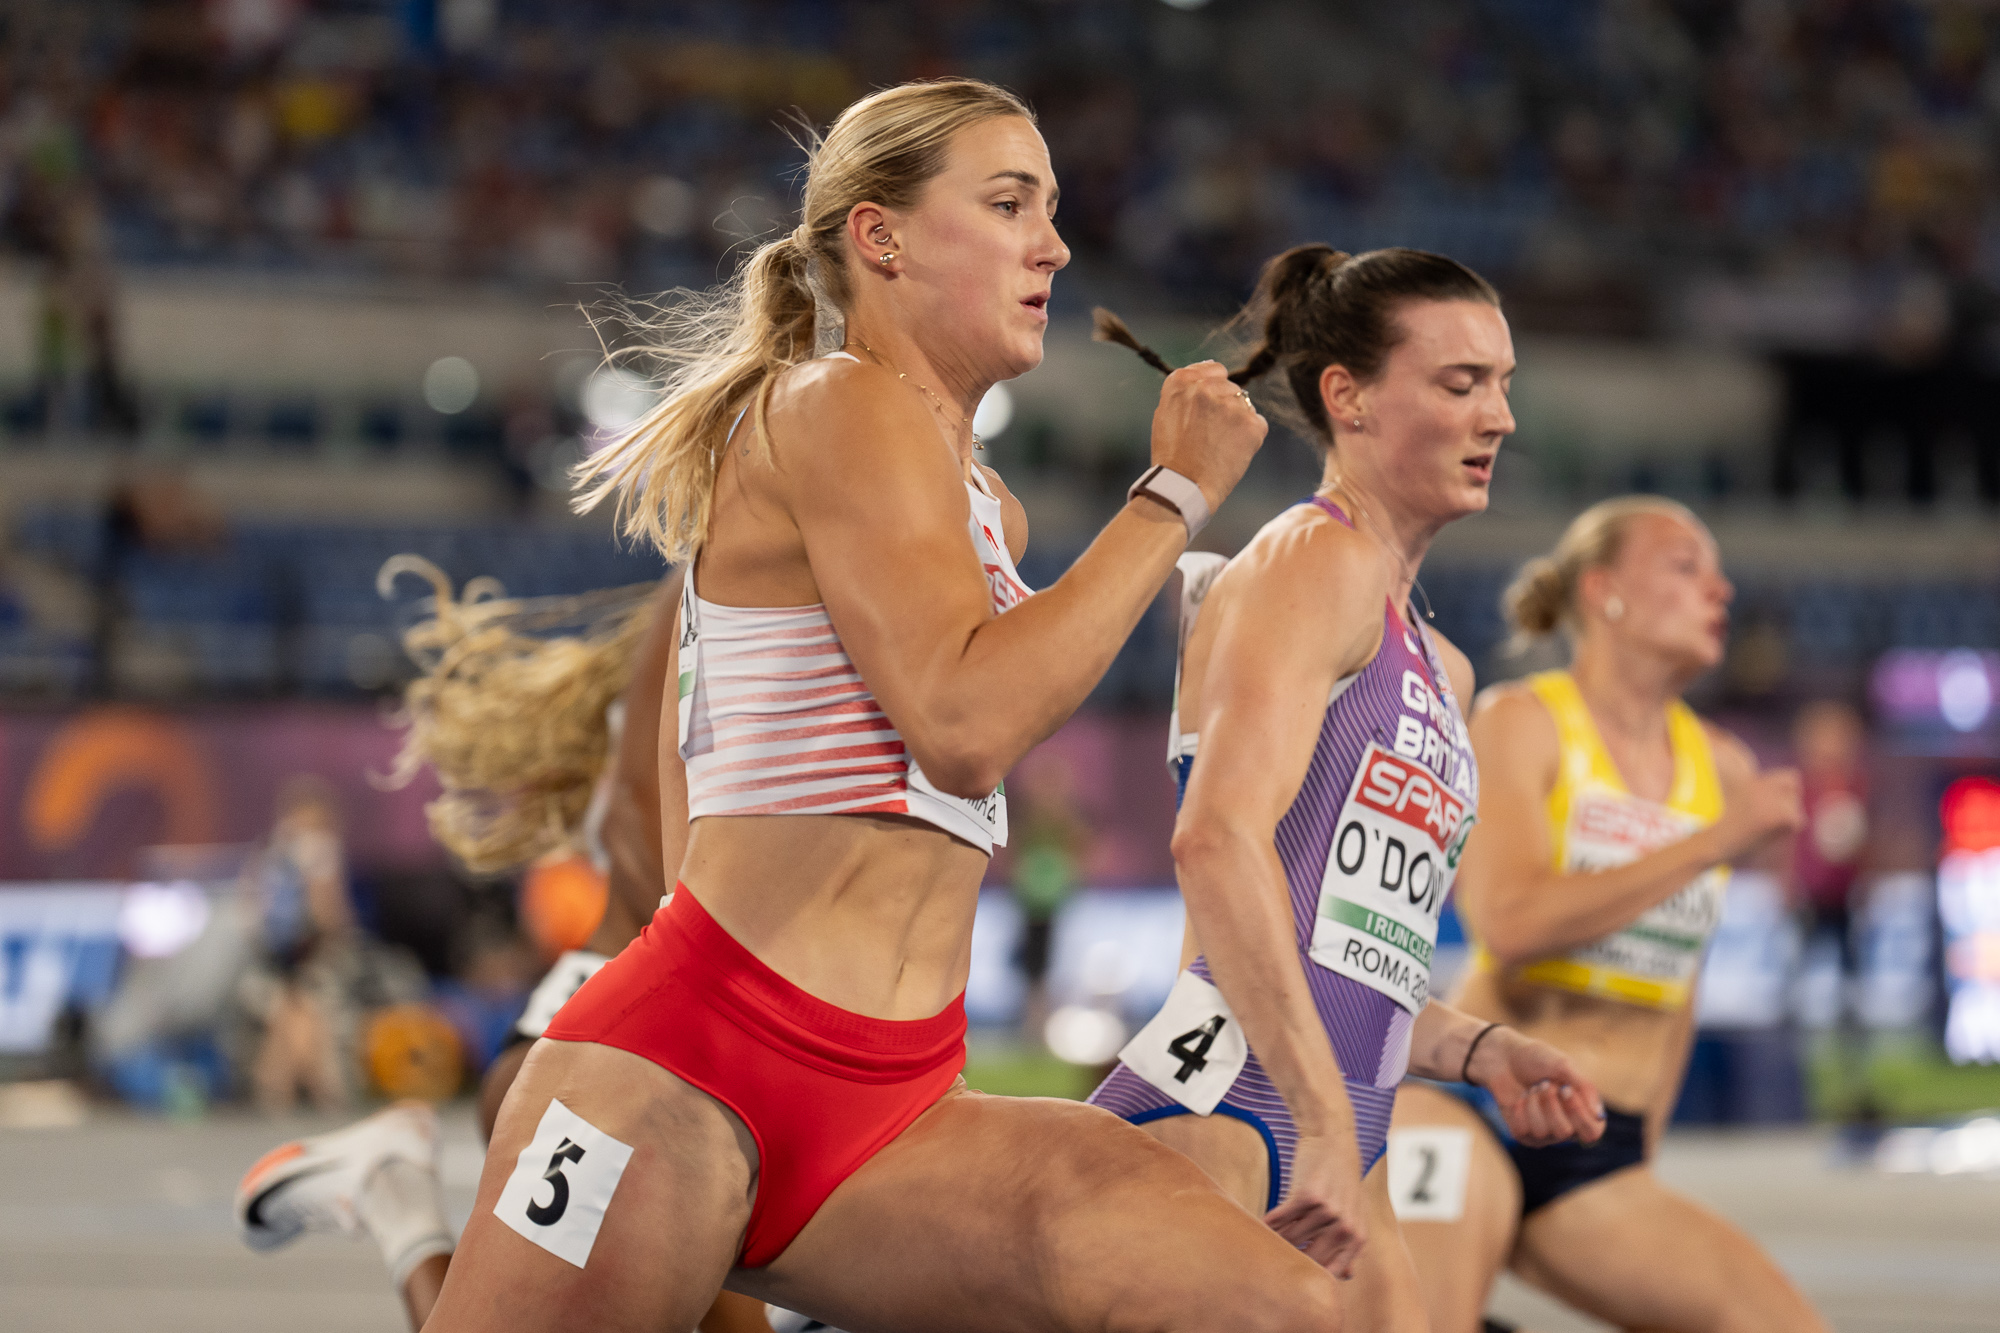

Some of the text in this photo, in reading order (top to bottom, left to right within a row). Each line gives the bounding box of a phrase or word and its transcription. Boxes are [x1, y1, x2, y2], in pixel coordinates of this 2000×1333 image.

[1365, 911, 1374, 932] I
[1373, 916, 1411, 950] RUN
[1344, 938, 1409, 993] ROMA
[1167, 1014, 1227, 1085] 4
[525, 1137, 587, 1227] 5
[1408, 1144, 1442, 1204] 2
